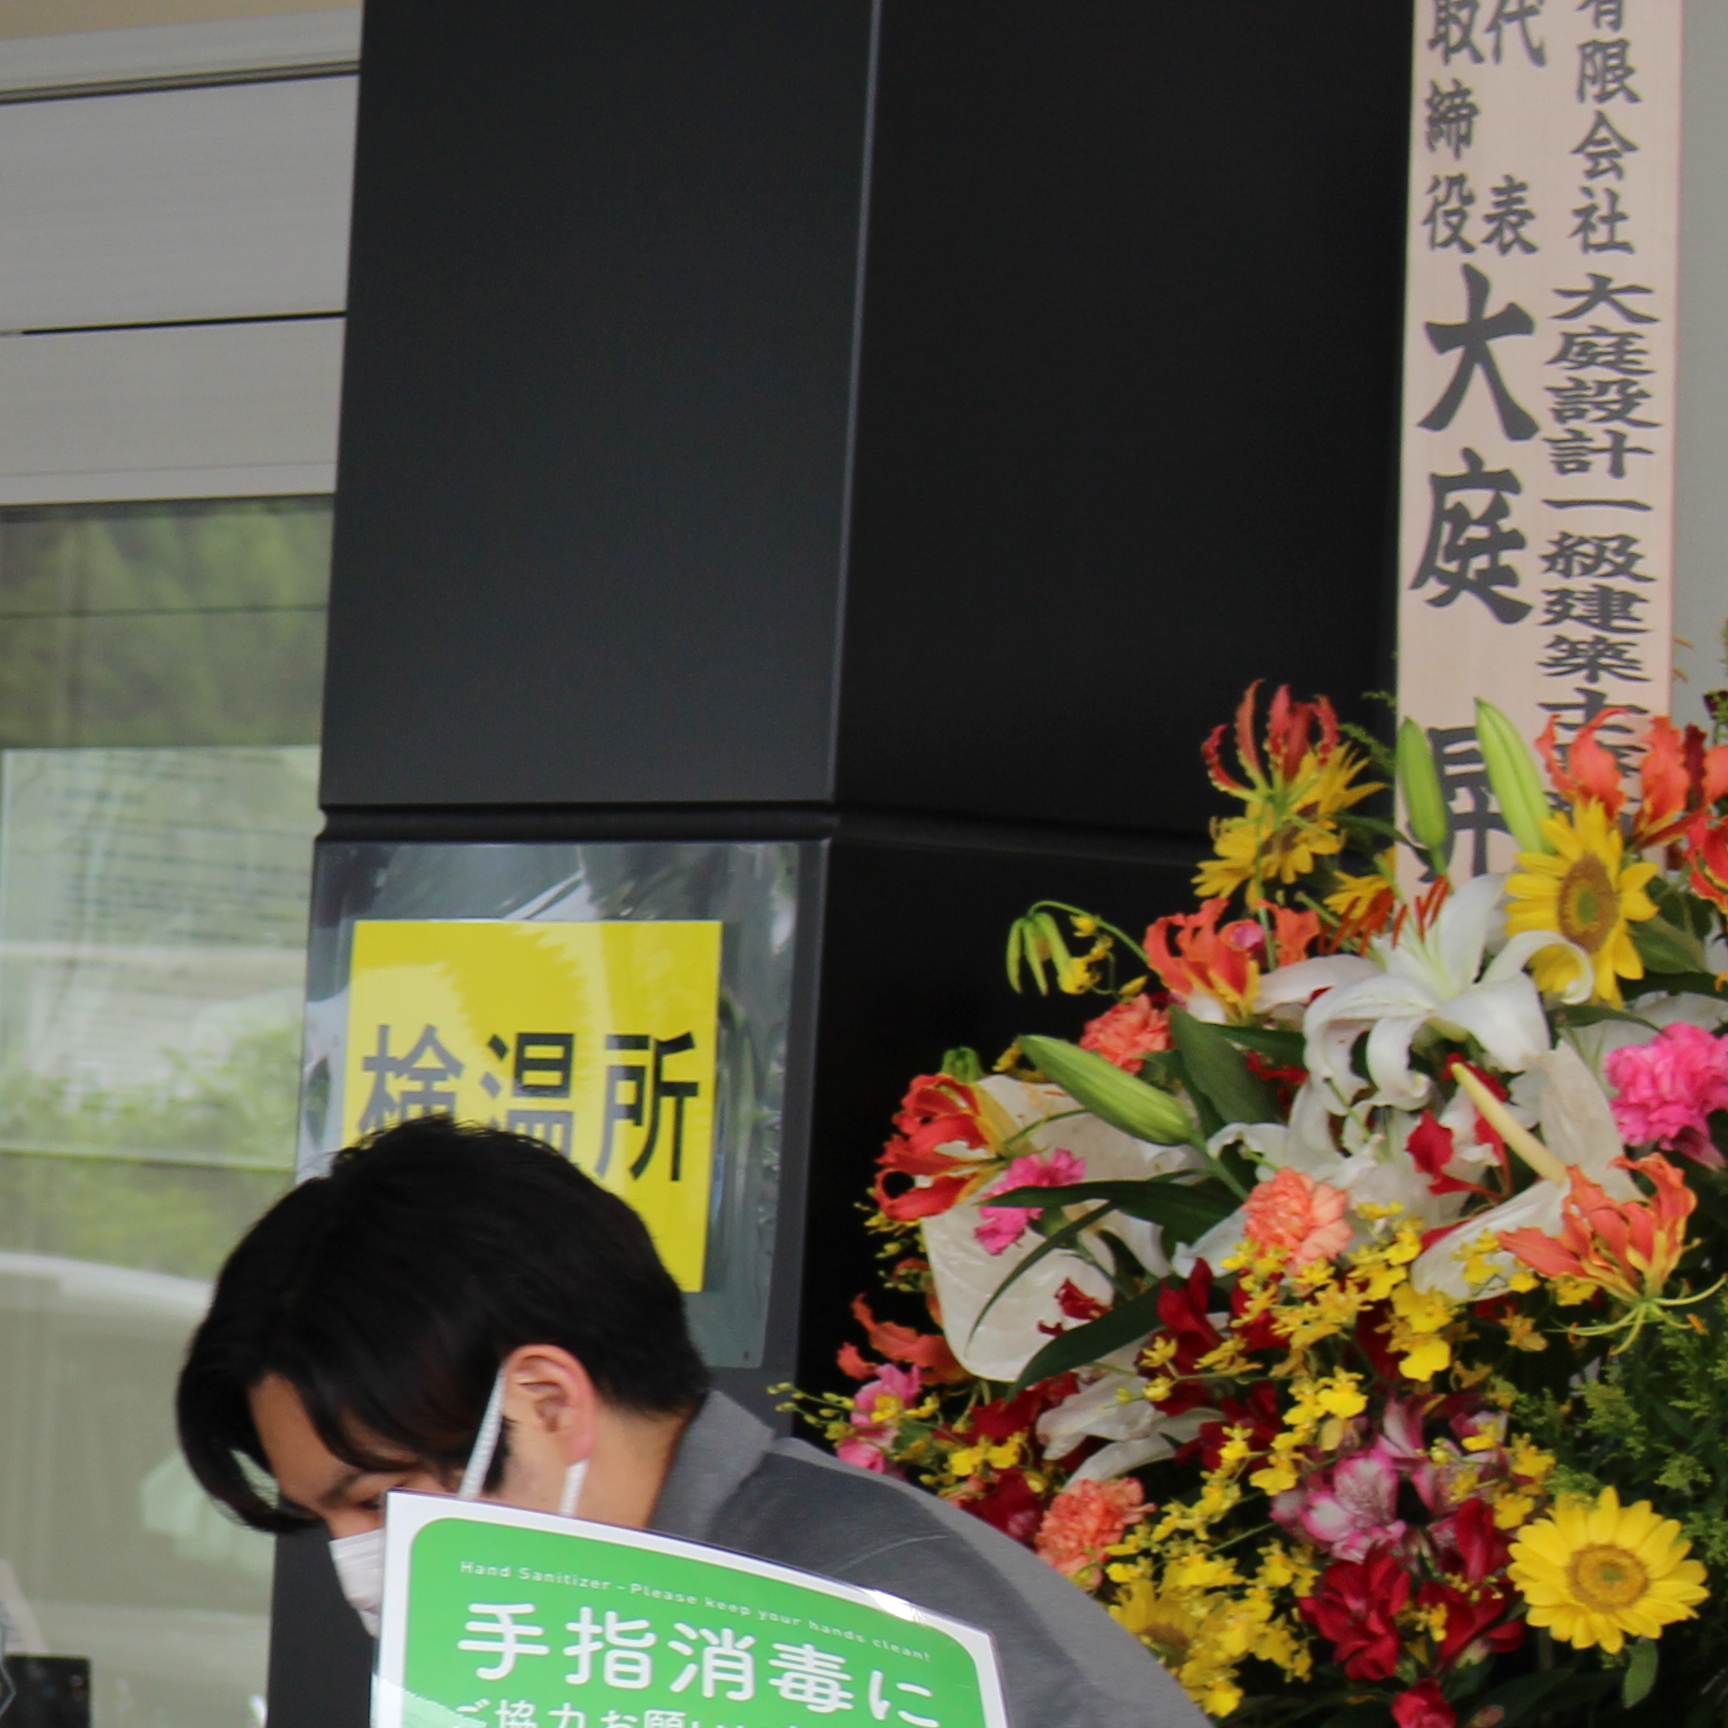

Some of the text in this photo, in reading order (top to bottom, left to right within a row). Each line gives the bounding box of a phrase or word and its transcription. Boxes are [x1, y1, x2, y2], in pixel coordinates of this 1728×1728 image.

[1409, 262, 1540, 625] 大庭
[358, 1023, 700, 1182] 検温所
[460, 1560, 511, 1578] Hand
[518, 1566, 610, 1590] Sanitizer
[630, 1582, 698, 1606] Please
[704, 1595, 752, 1618] keep
[758, 1608, 802, 1630] your
[808, 1618, 865, 1644] hands
[871, 1635, 932, 1663] clean!
